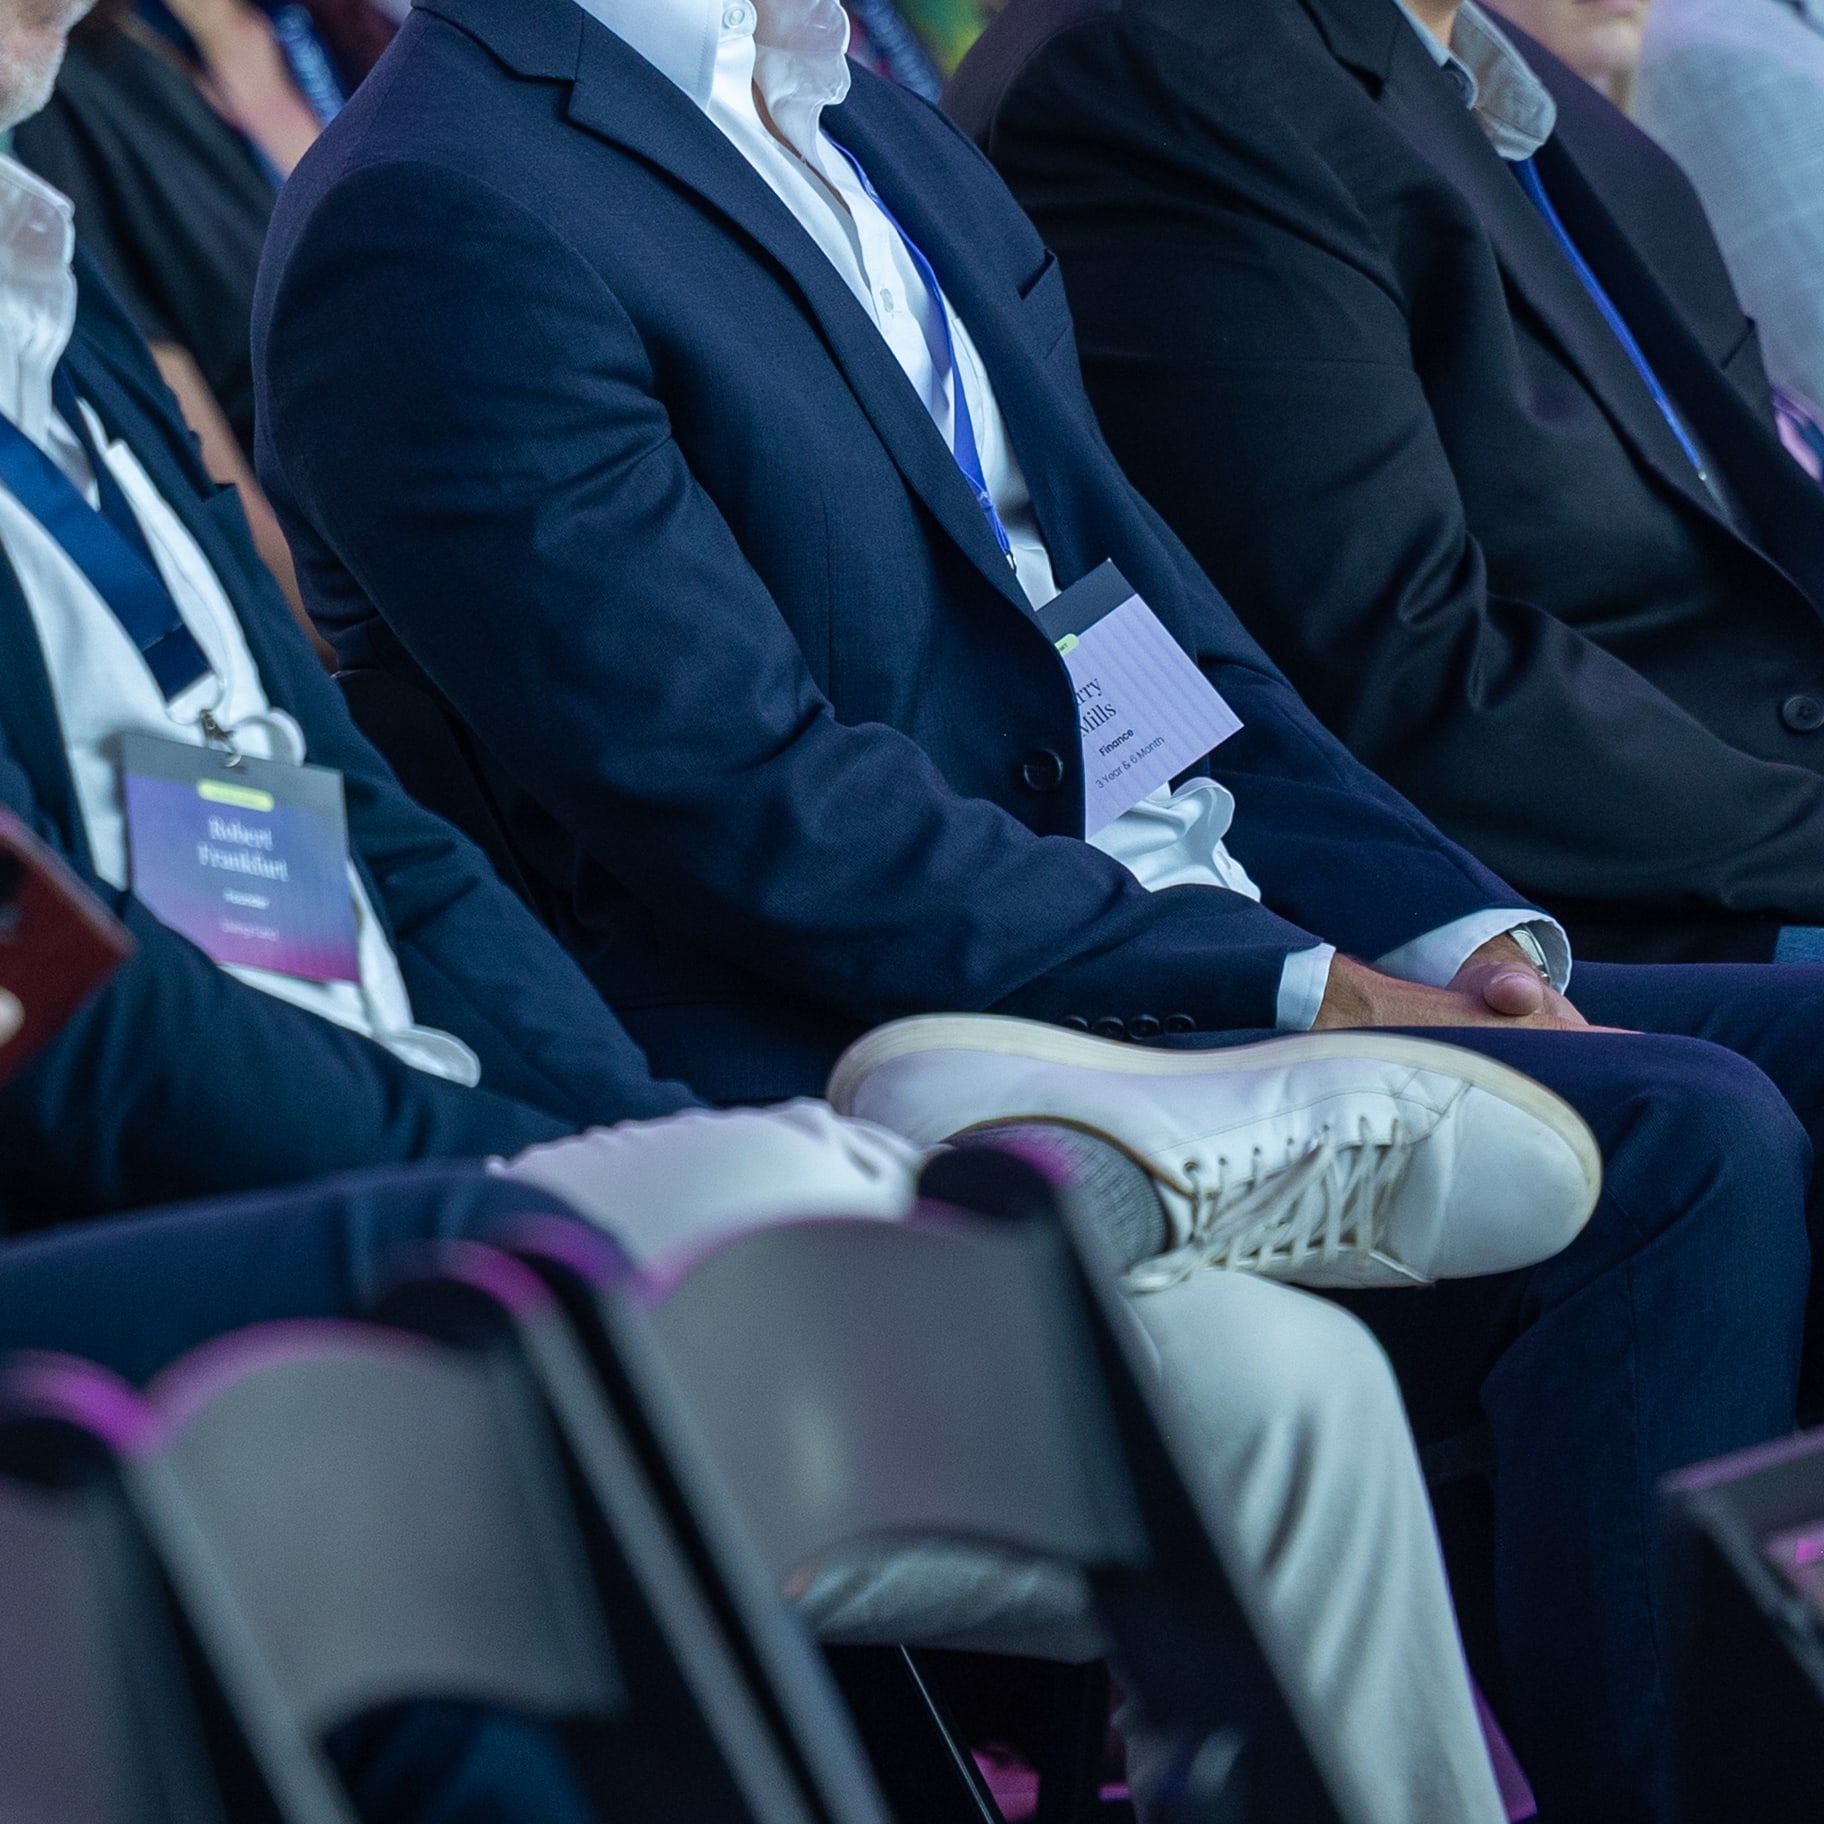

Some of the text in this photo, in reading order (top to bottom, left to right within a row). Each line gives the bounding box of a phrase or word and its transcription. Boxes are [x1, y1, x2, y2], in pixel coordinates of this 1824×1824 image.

[1095, 736, 1165, 789] 3 Year & 6 Month
[1099, 729, 1134, 757] Finance
